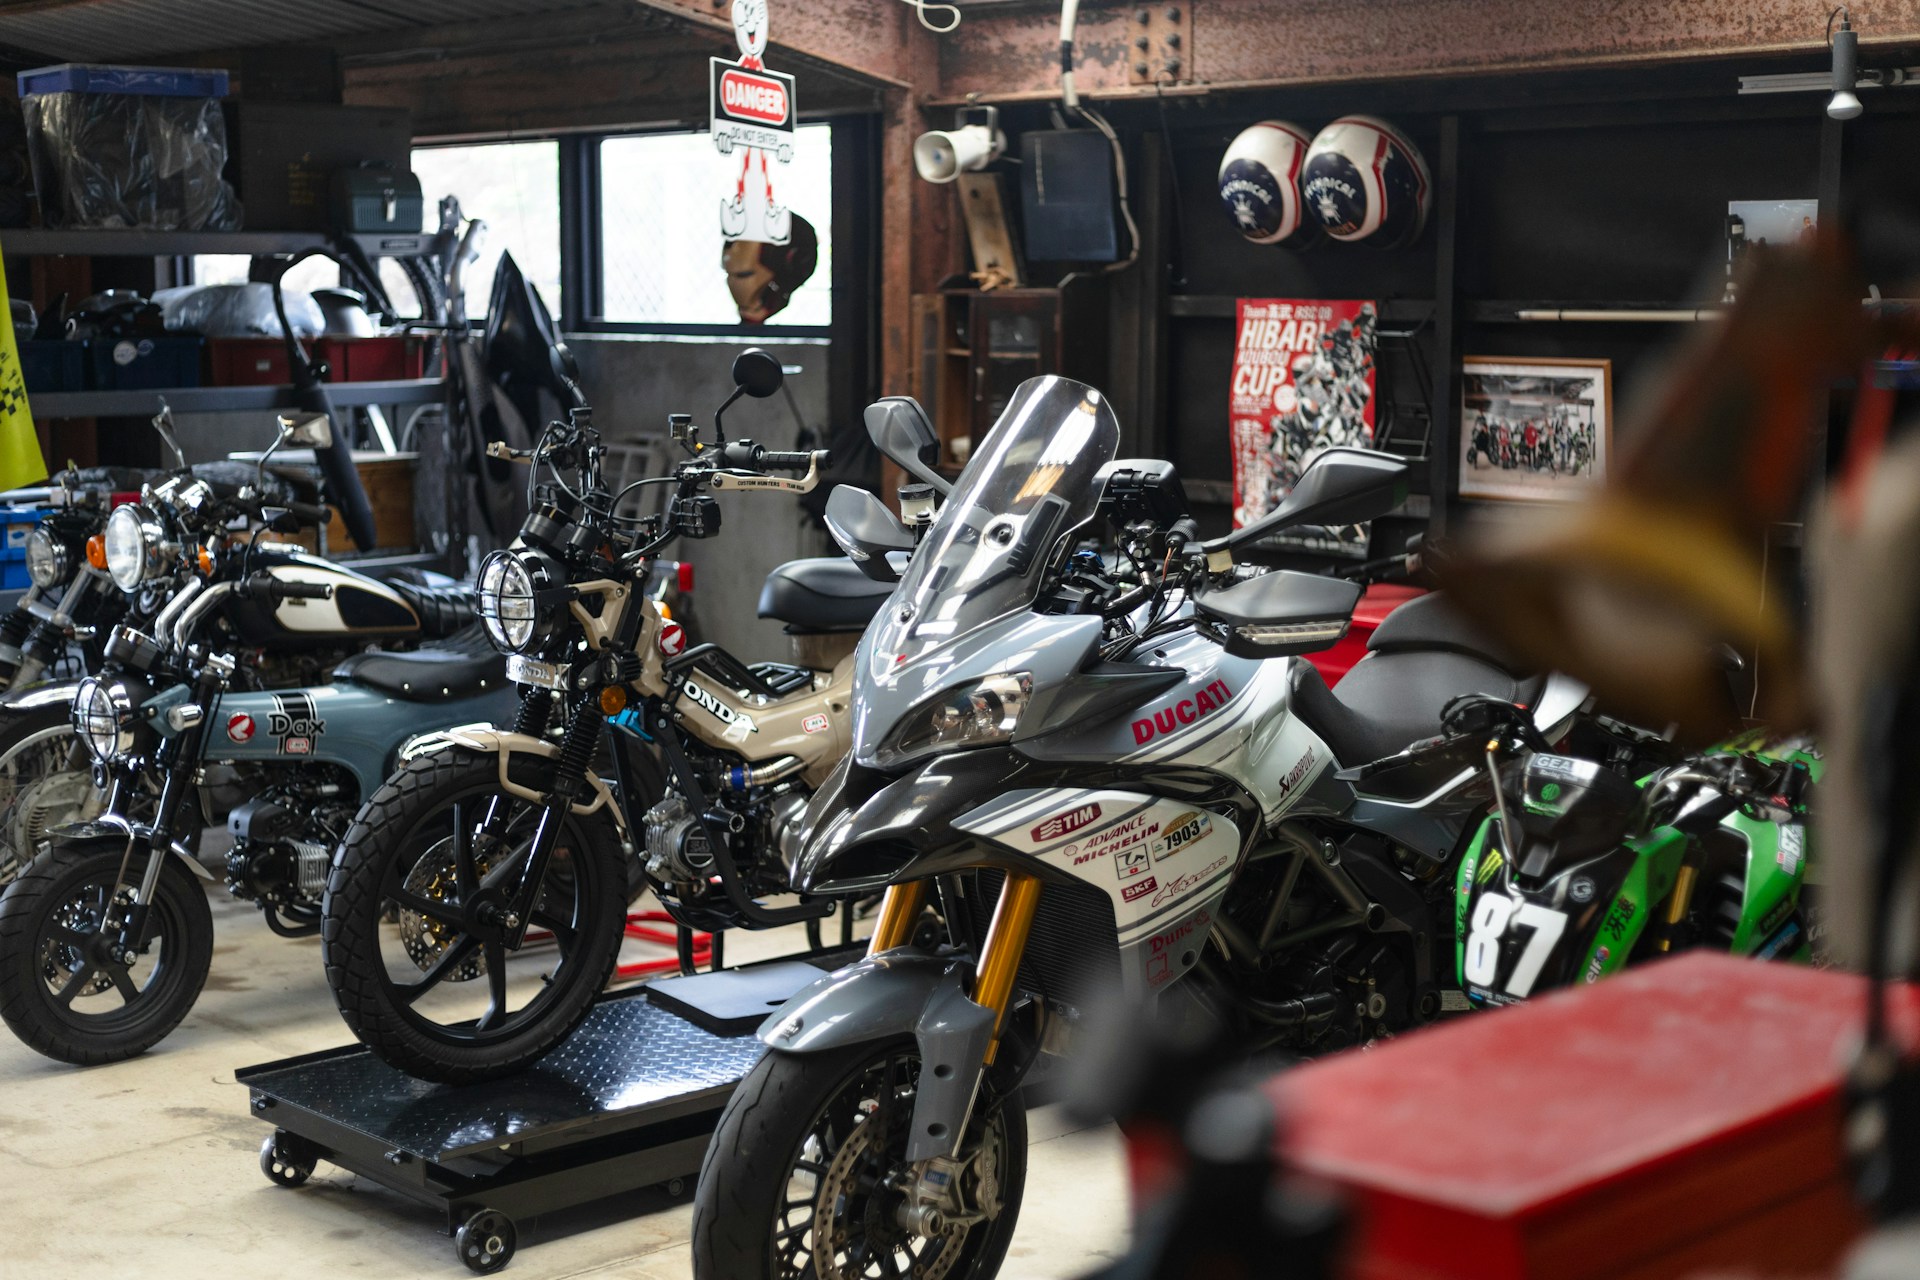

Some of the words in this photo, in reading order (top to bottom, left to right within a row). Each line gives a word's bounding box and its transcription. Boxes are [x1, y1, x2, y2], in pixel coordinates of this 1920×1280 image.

[725, 79, 786, 116] DANGER
[743, 130, 756, 141] NOT
[757, 131, 778, 145] ENTER
[1233, 365, 1287, 396] CUP
[267, 712, 326, 737] Dax
[1131, 678, 1232, 746] DUCATI
[1062, 806, 1095, 830] TIM
[1083, 812, 1147, 851] ADVANCE
[1073, 822, 1159, 866] MICHELIN
[1164, 819, 1200, 850] 7903
[1464, 858, 1474, 883] elf
[1125, 878, 1153, 897] SKF
[1464, 891, 1568, 998] 87
[1586, 958, 1602, 984] elf
